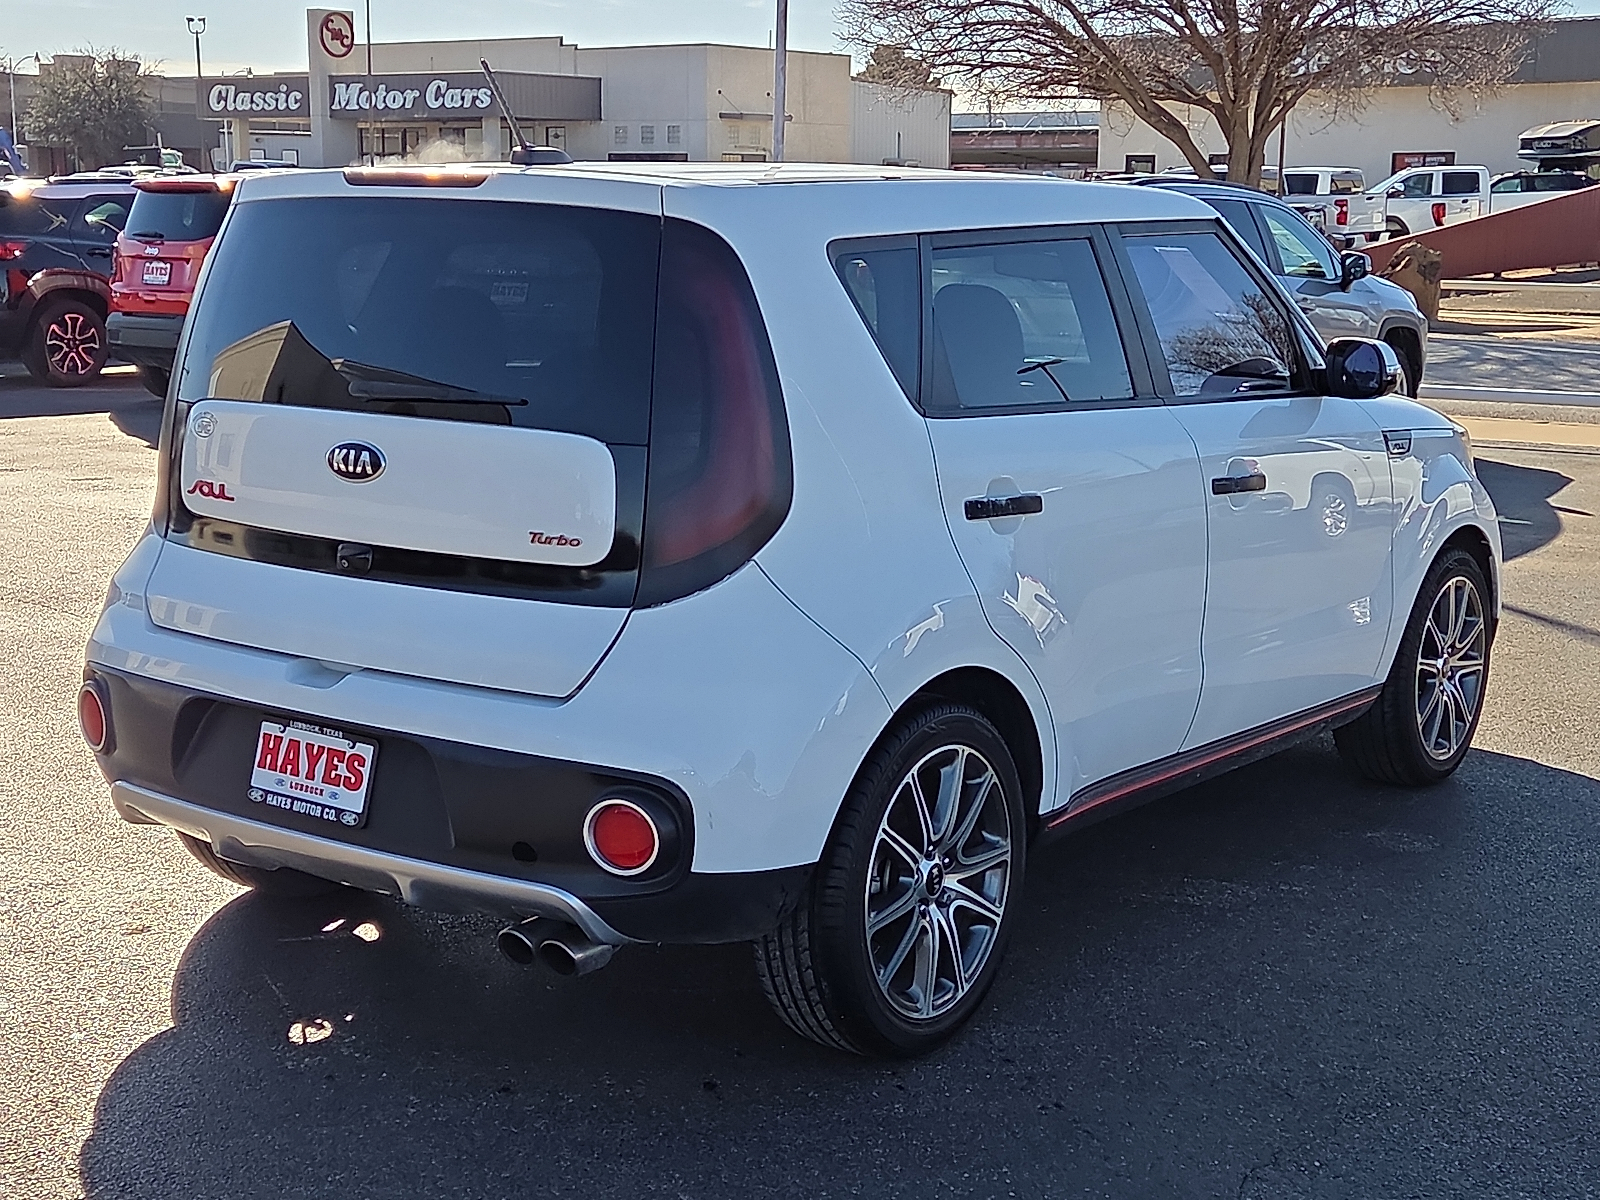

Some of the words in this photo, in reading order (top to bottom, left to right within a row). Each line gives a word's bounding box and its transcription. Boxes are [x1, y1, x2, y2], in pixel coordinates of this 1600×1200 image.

[208, 84, 303, 112] Classic
[331, 82, 420, 110] Motor
[425, 79, 492, 109] Cars
[333, 448, 374, 475] KIA
[528, 530, 583, 548] Turbo
[322, 727, 344, 739] TEXAS
[256, 731, 367, 793] HAYES
[289, 780, 325, 797] LUBBOCK
[266, 793, 292, 809] HAYES
[292, 800, 322, 817] MOTOR
[323, 808, 338, 821] CO.
